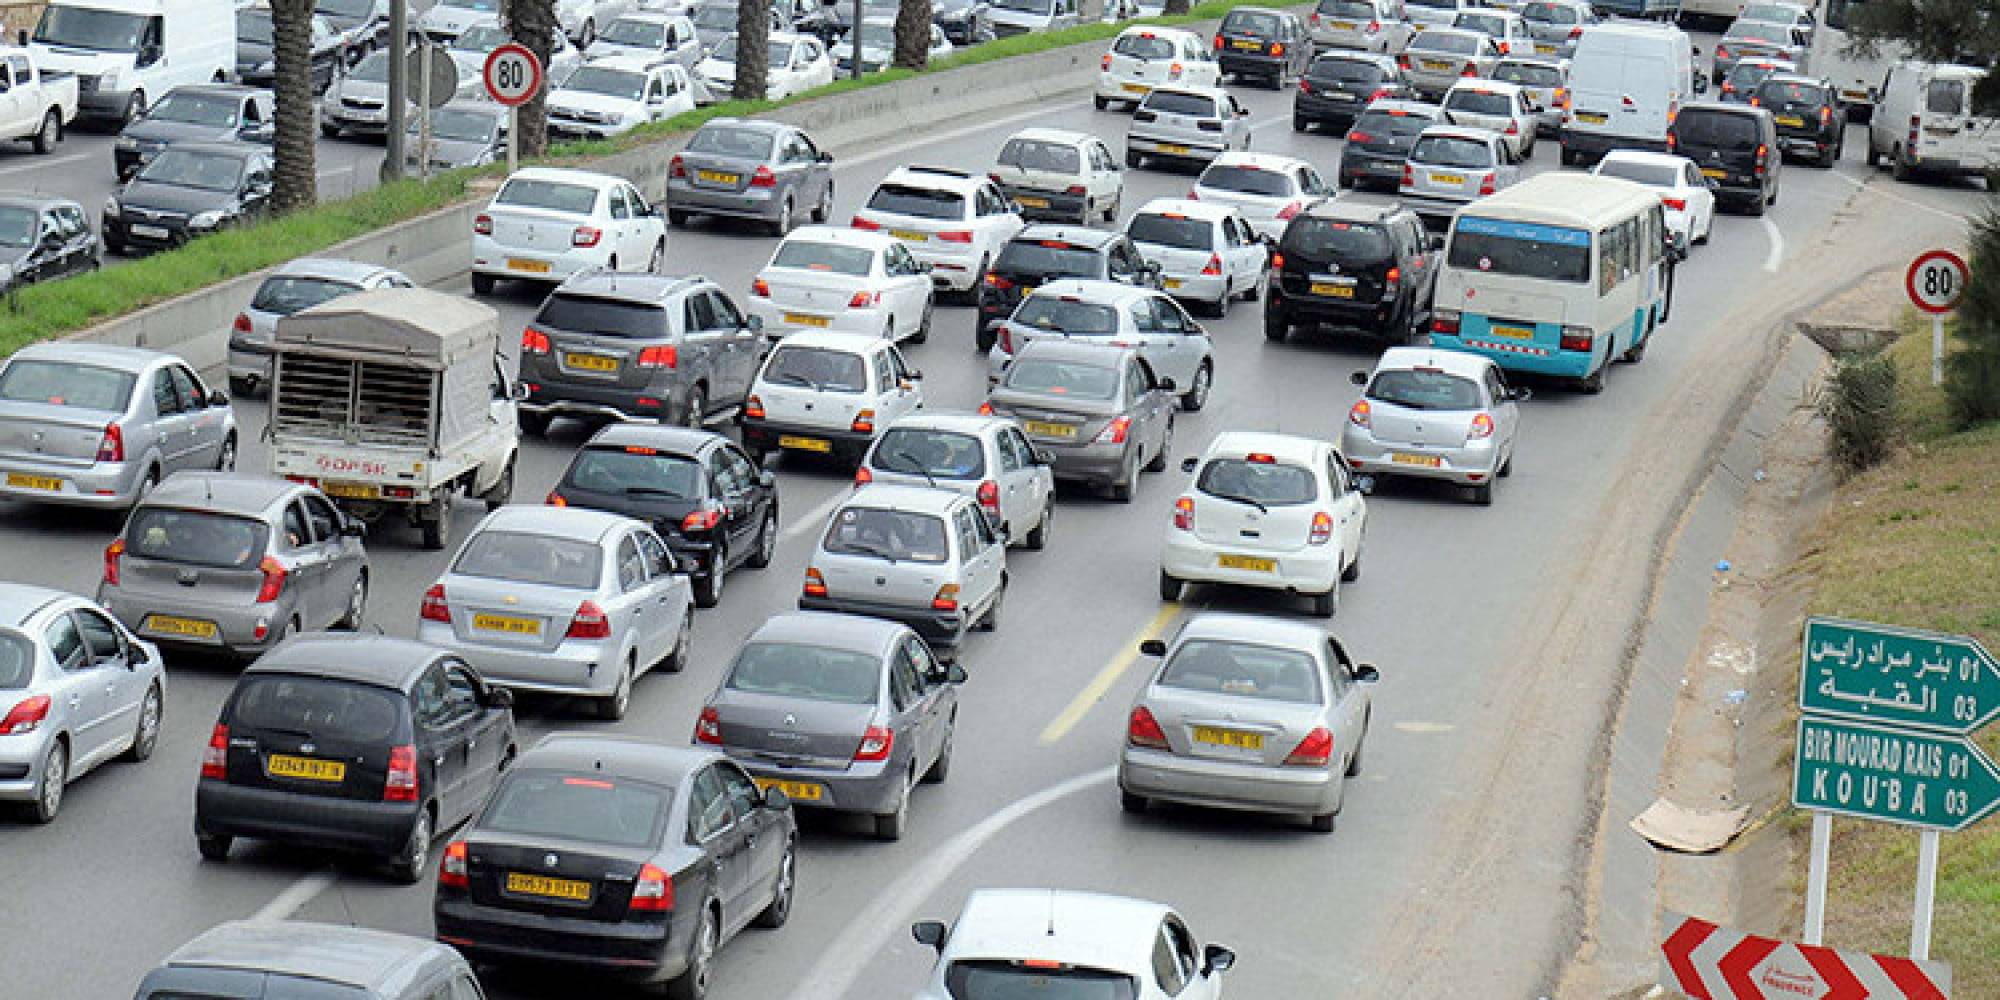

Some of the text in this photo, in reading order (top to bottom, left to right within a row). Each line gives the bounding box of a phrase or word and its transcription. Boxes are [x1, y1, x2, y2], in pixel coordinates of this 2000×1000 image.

[498, 61, 523, 88] 80
[1925, 266, 1952, 296] 80
[1959, 656, 1980, 683] 01
[1954, 695, 1977, 720] 03
[1804, 727, 1969, 780] BIR MOURAD RAIS 01
[1945, 788, 1969, 816] 03
